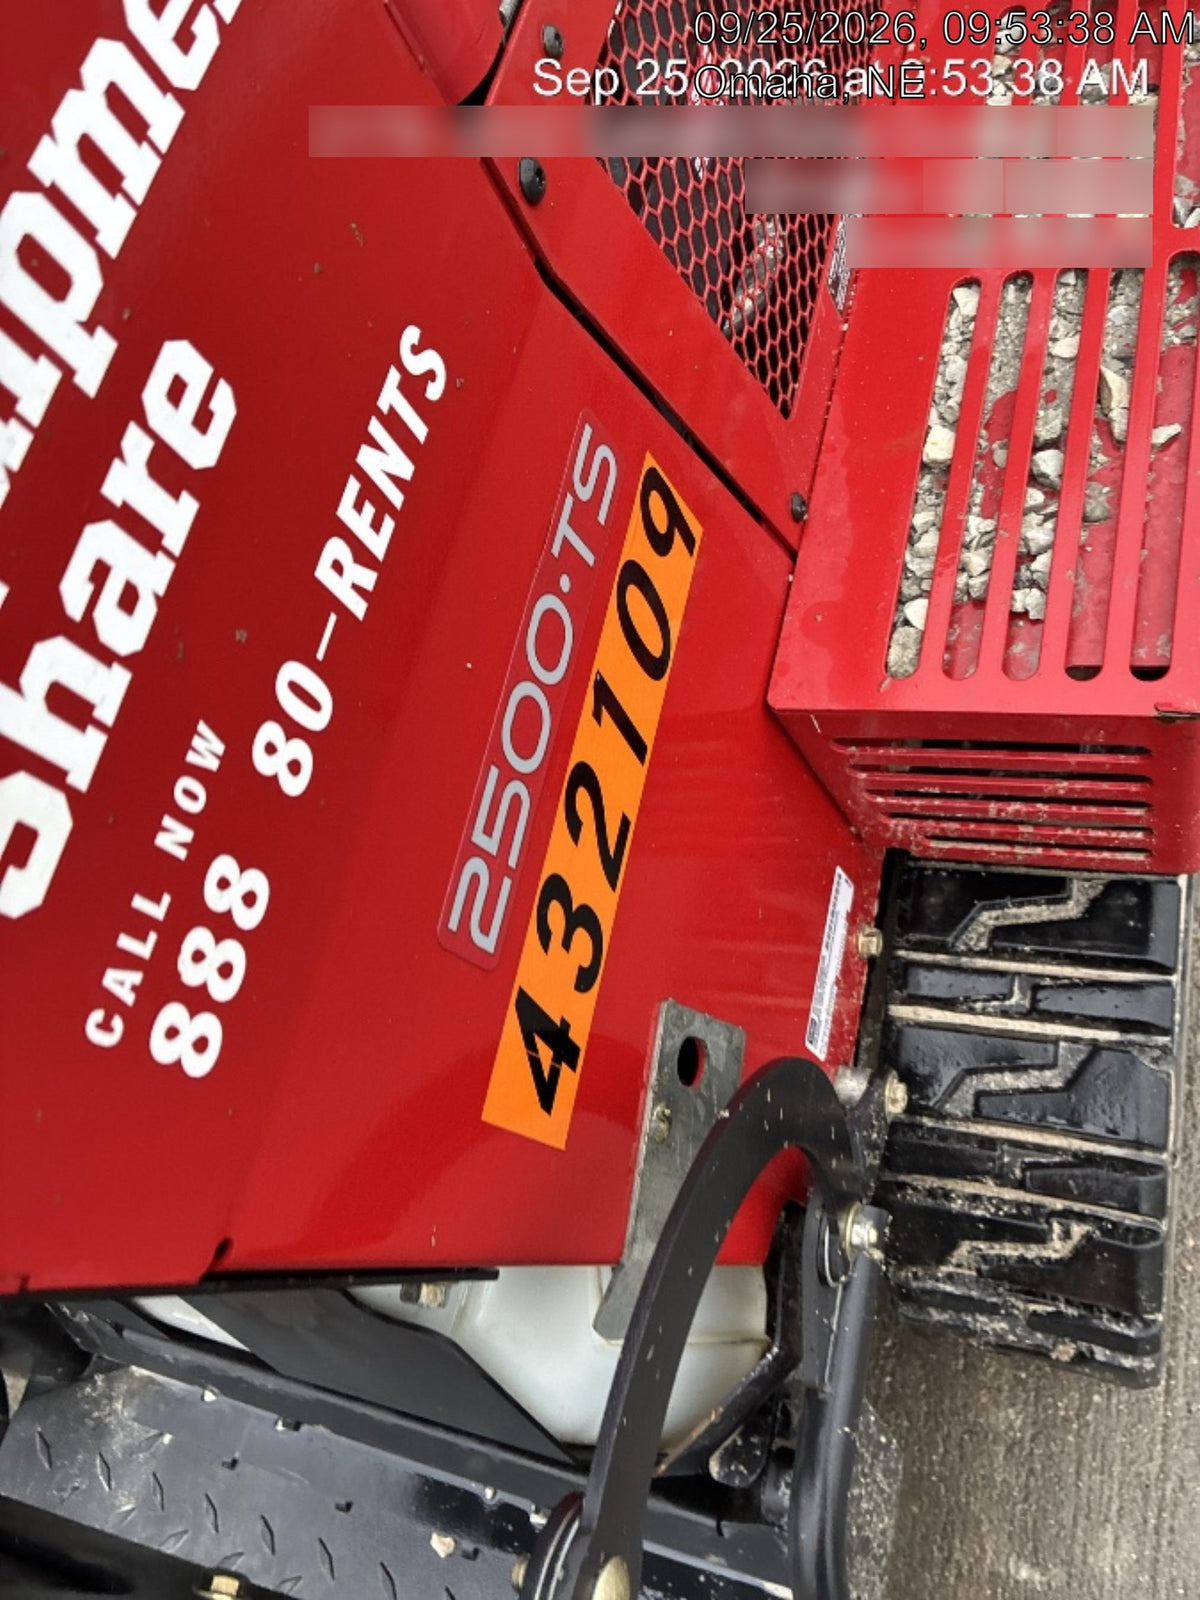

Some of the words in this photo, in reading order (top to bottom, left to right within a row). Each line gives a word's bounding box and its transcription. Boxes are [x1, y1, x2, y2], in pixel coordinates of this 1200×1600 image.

[86, 893, 170, 1047] CALL
[155, 720, 225, 861] NOW
[515, 467, 696, 1116] 432109
[150, 855, 269, 1077] 888
